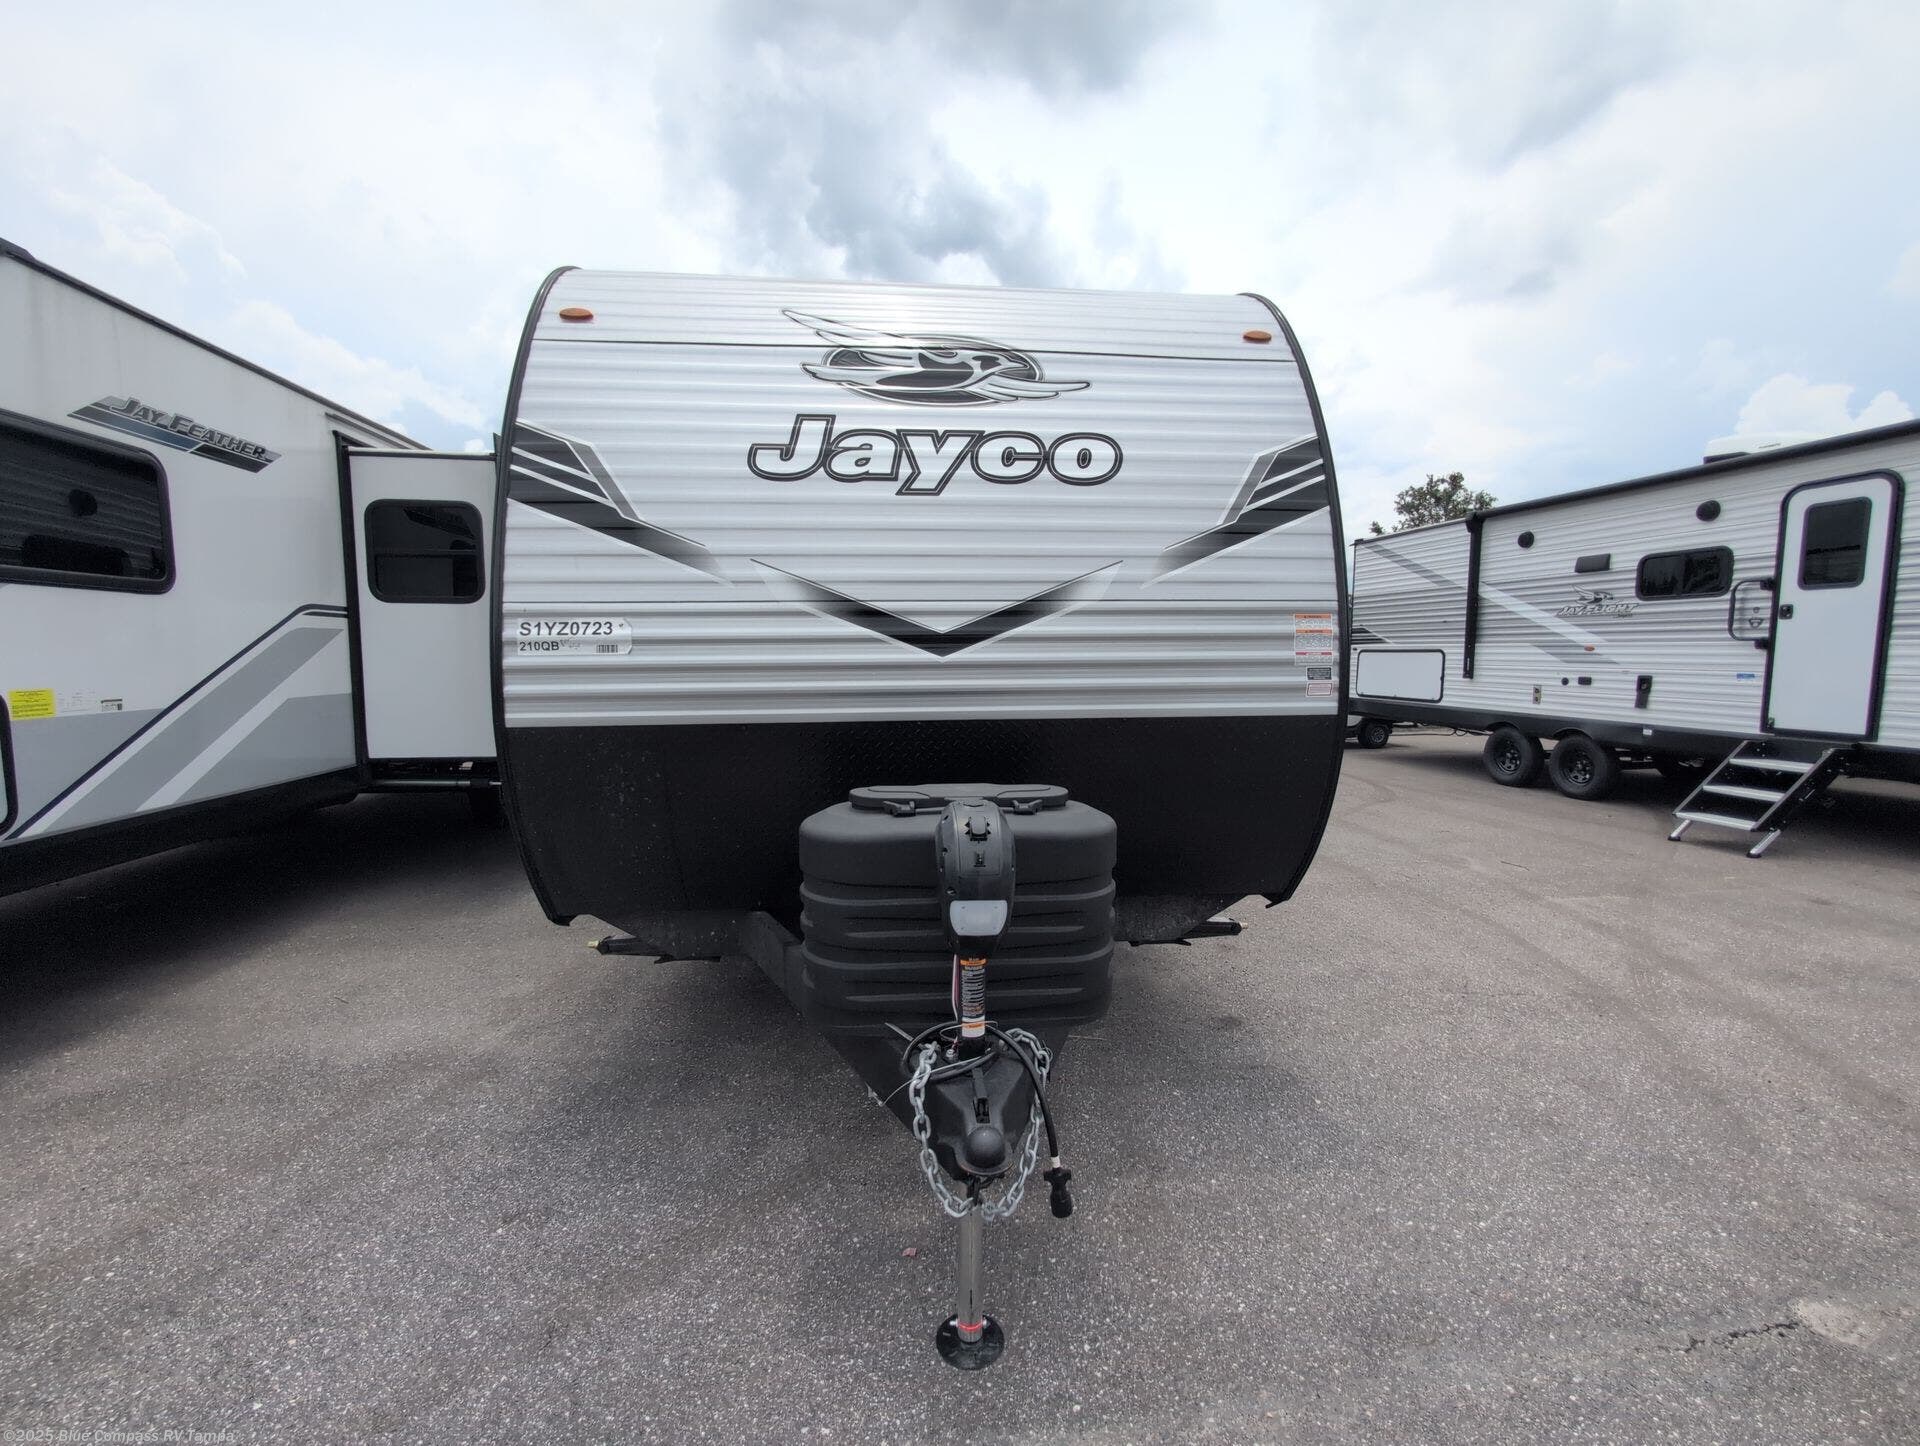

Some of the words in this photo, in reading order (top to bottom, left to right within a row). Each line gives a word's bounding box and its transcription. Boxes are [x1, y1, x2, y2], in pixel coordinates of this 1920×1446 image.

[110, 397, 167, 427] JAY
[169, 413, 267, 460] FEATHER
[747, 413, 1124, 496] Jayco
[519, 621, 613, 636] S1YZ0723
[519, 641, 560, 651] 210QB
